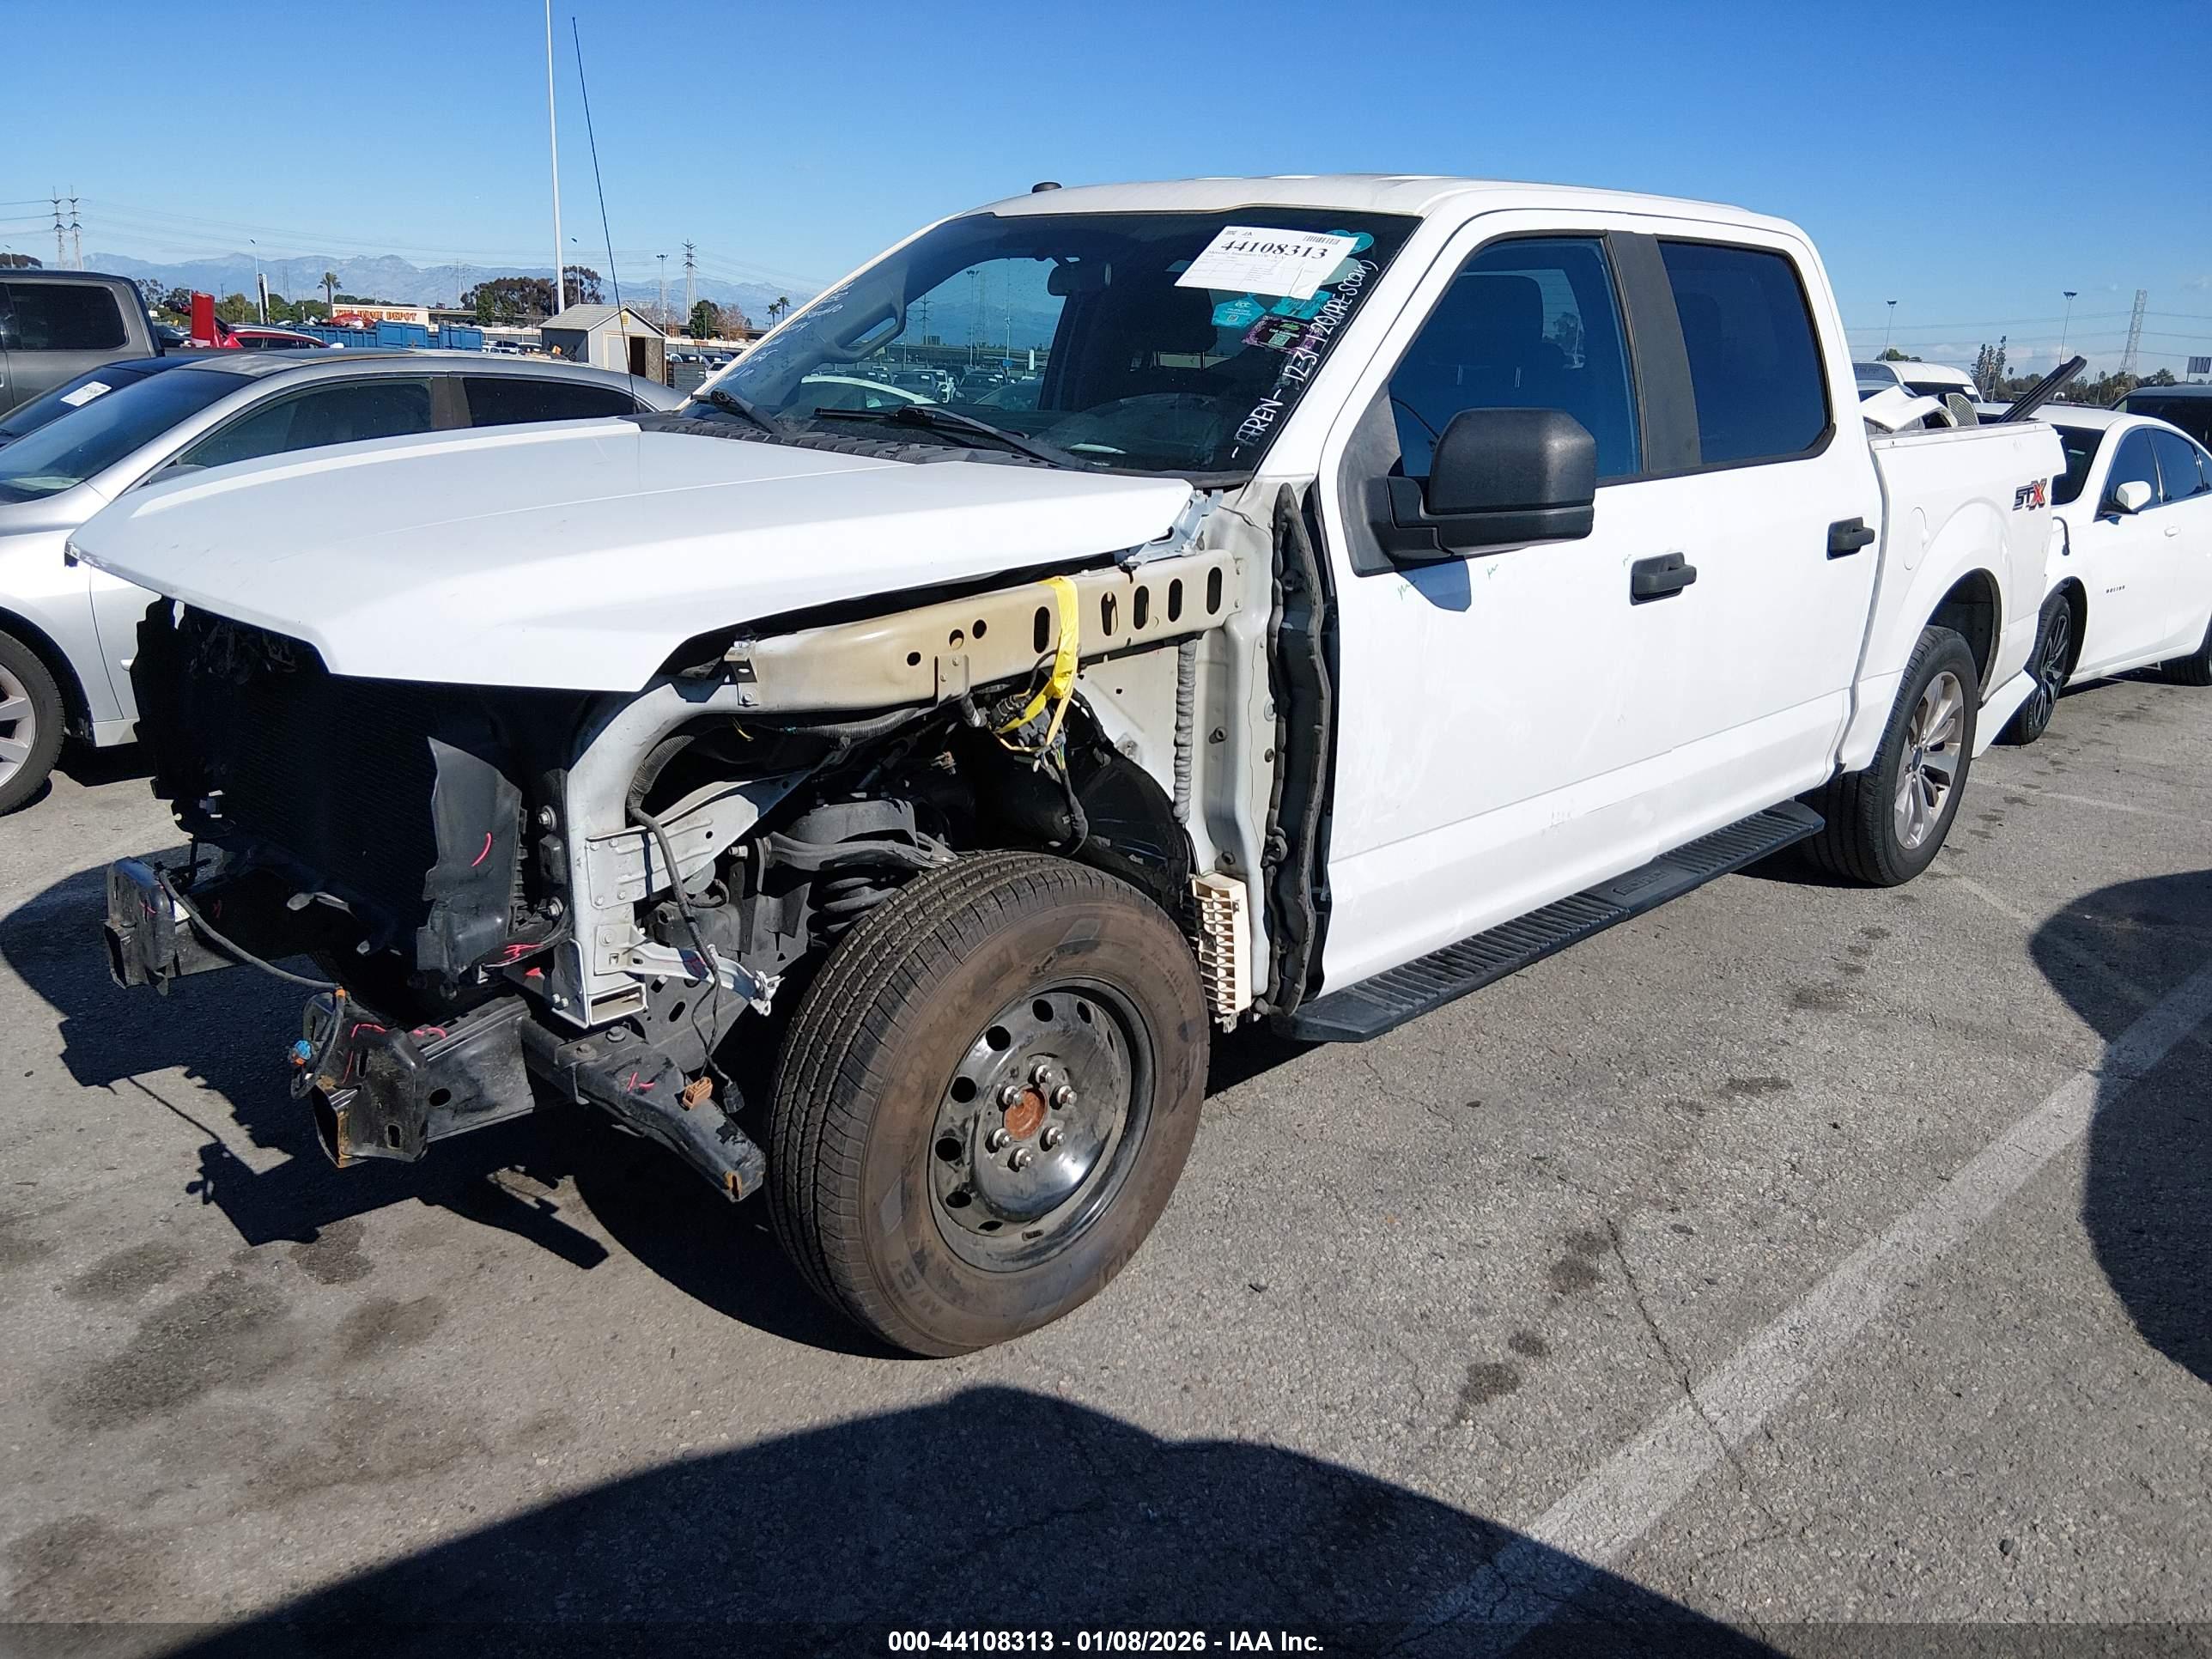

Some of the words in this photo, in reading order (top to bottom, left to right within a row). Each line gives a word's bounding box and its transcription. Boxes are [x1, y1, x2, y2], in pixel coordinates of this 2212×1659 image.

[1221, 240, 1328, 259] 44108313
[386, 312, 417, 321] DEPOT
[2013, 478, 2047, 511] STX
